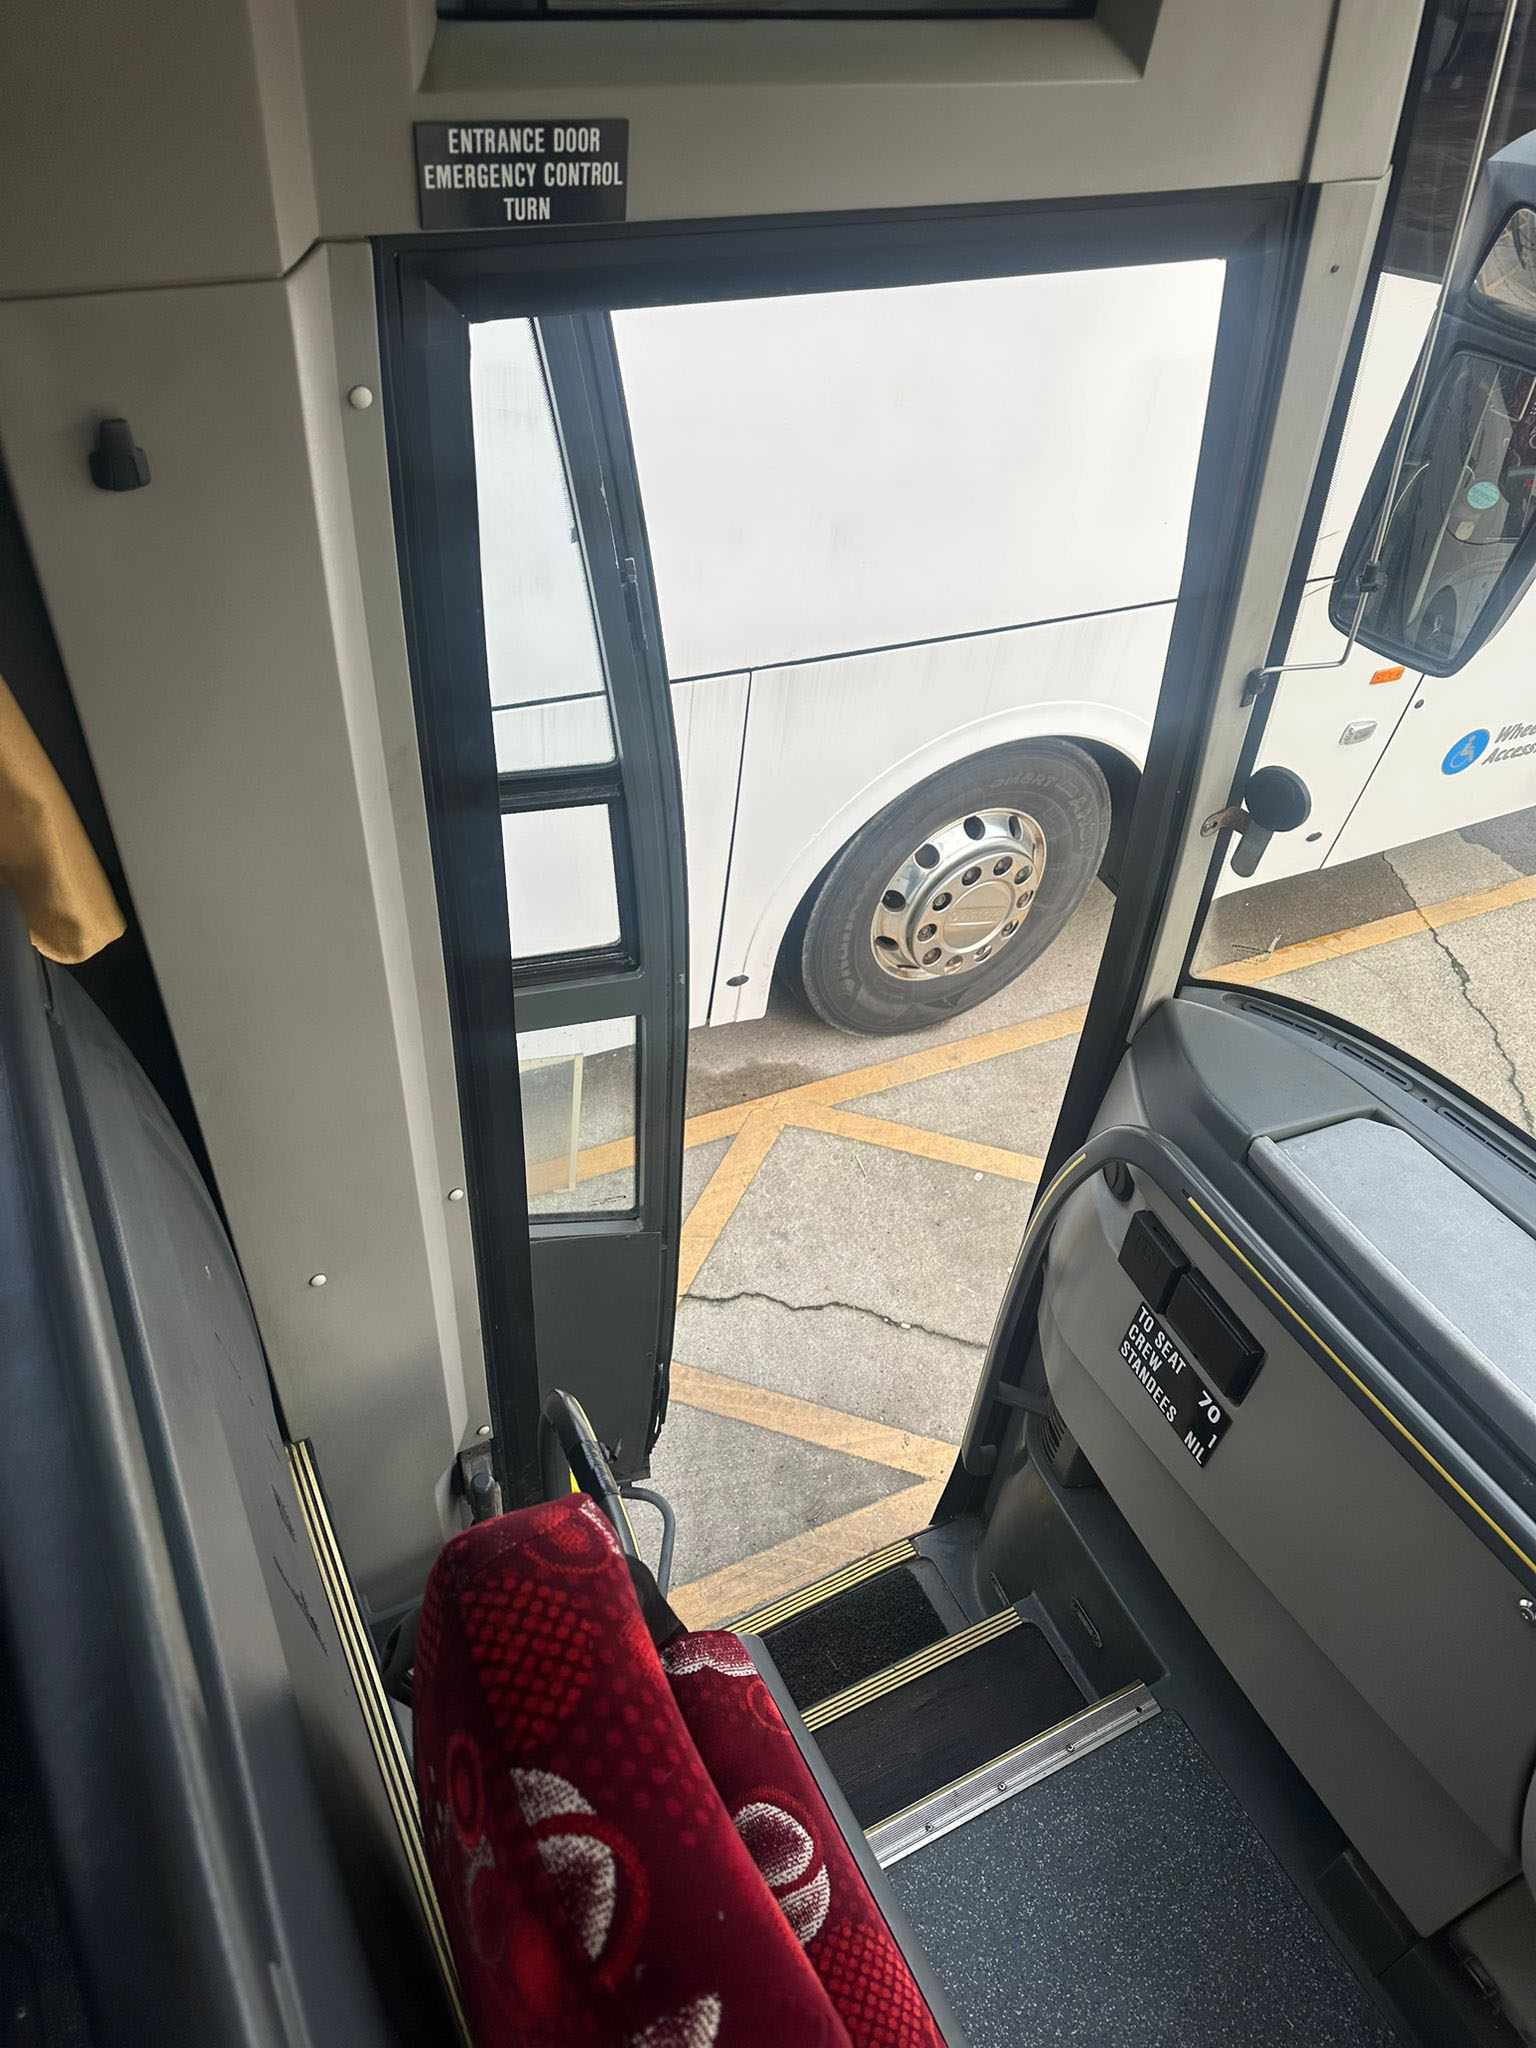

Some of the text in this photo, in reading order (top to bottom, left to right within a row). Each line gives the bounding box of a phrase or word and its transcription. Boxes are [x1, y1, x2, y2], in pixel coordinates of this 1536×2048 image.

[448, 127, 601, 155] ENTRANCE DOOR
[424, 161, 624, 190] EMERGENCY CONTROL
[503, 196, 551, 222] TURN
[1481, 742, 1536, 766] Access
[1138, 1305, 1222, 1425] TO SEAT 70
[1128, 1323, 1218, 1449] CREW 1
[1120, 1340, 1206, 1465] STANDEES NIL
